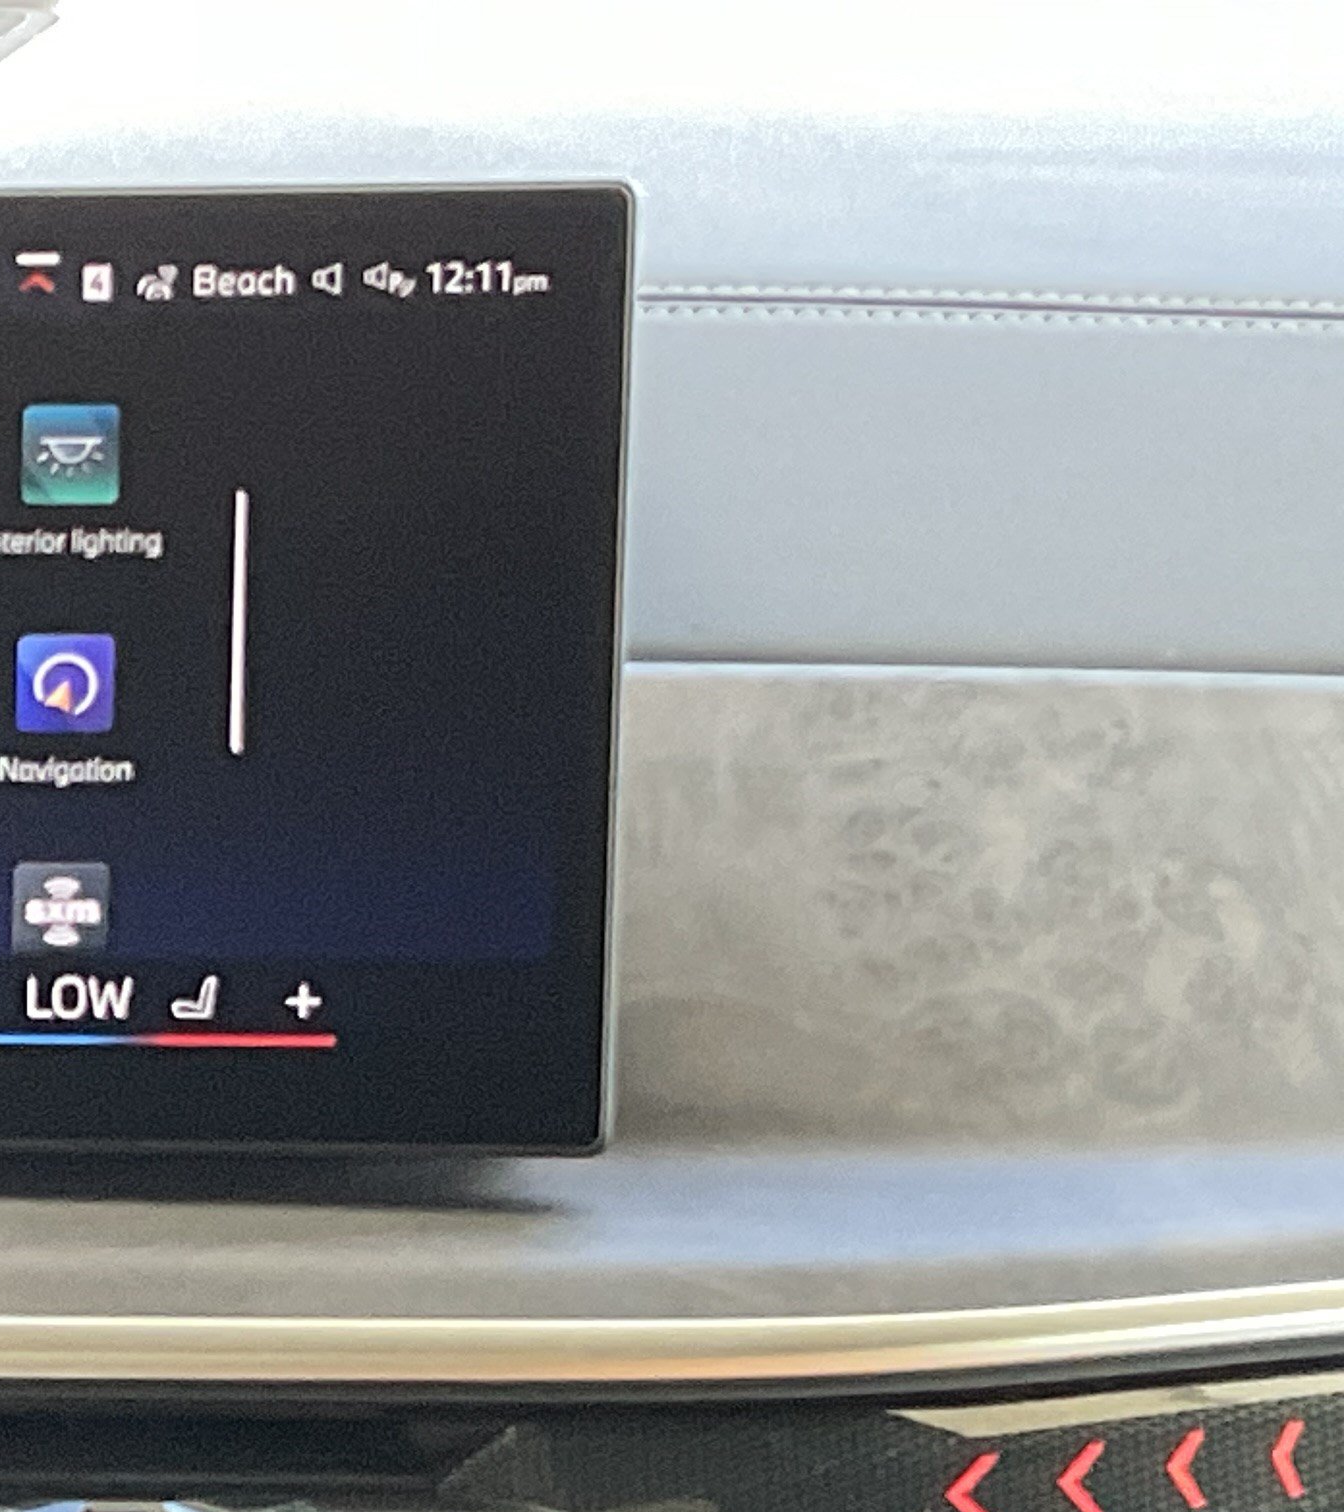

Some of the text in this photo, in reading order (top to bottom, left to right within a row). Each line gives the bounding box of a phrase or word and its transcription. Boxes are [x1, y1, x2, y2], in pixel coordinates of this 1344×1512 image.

[192, 264, 295, 297] Beach
[72, 529, 164, 560] lighting
[24, 974, 134, 1021] LOW
